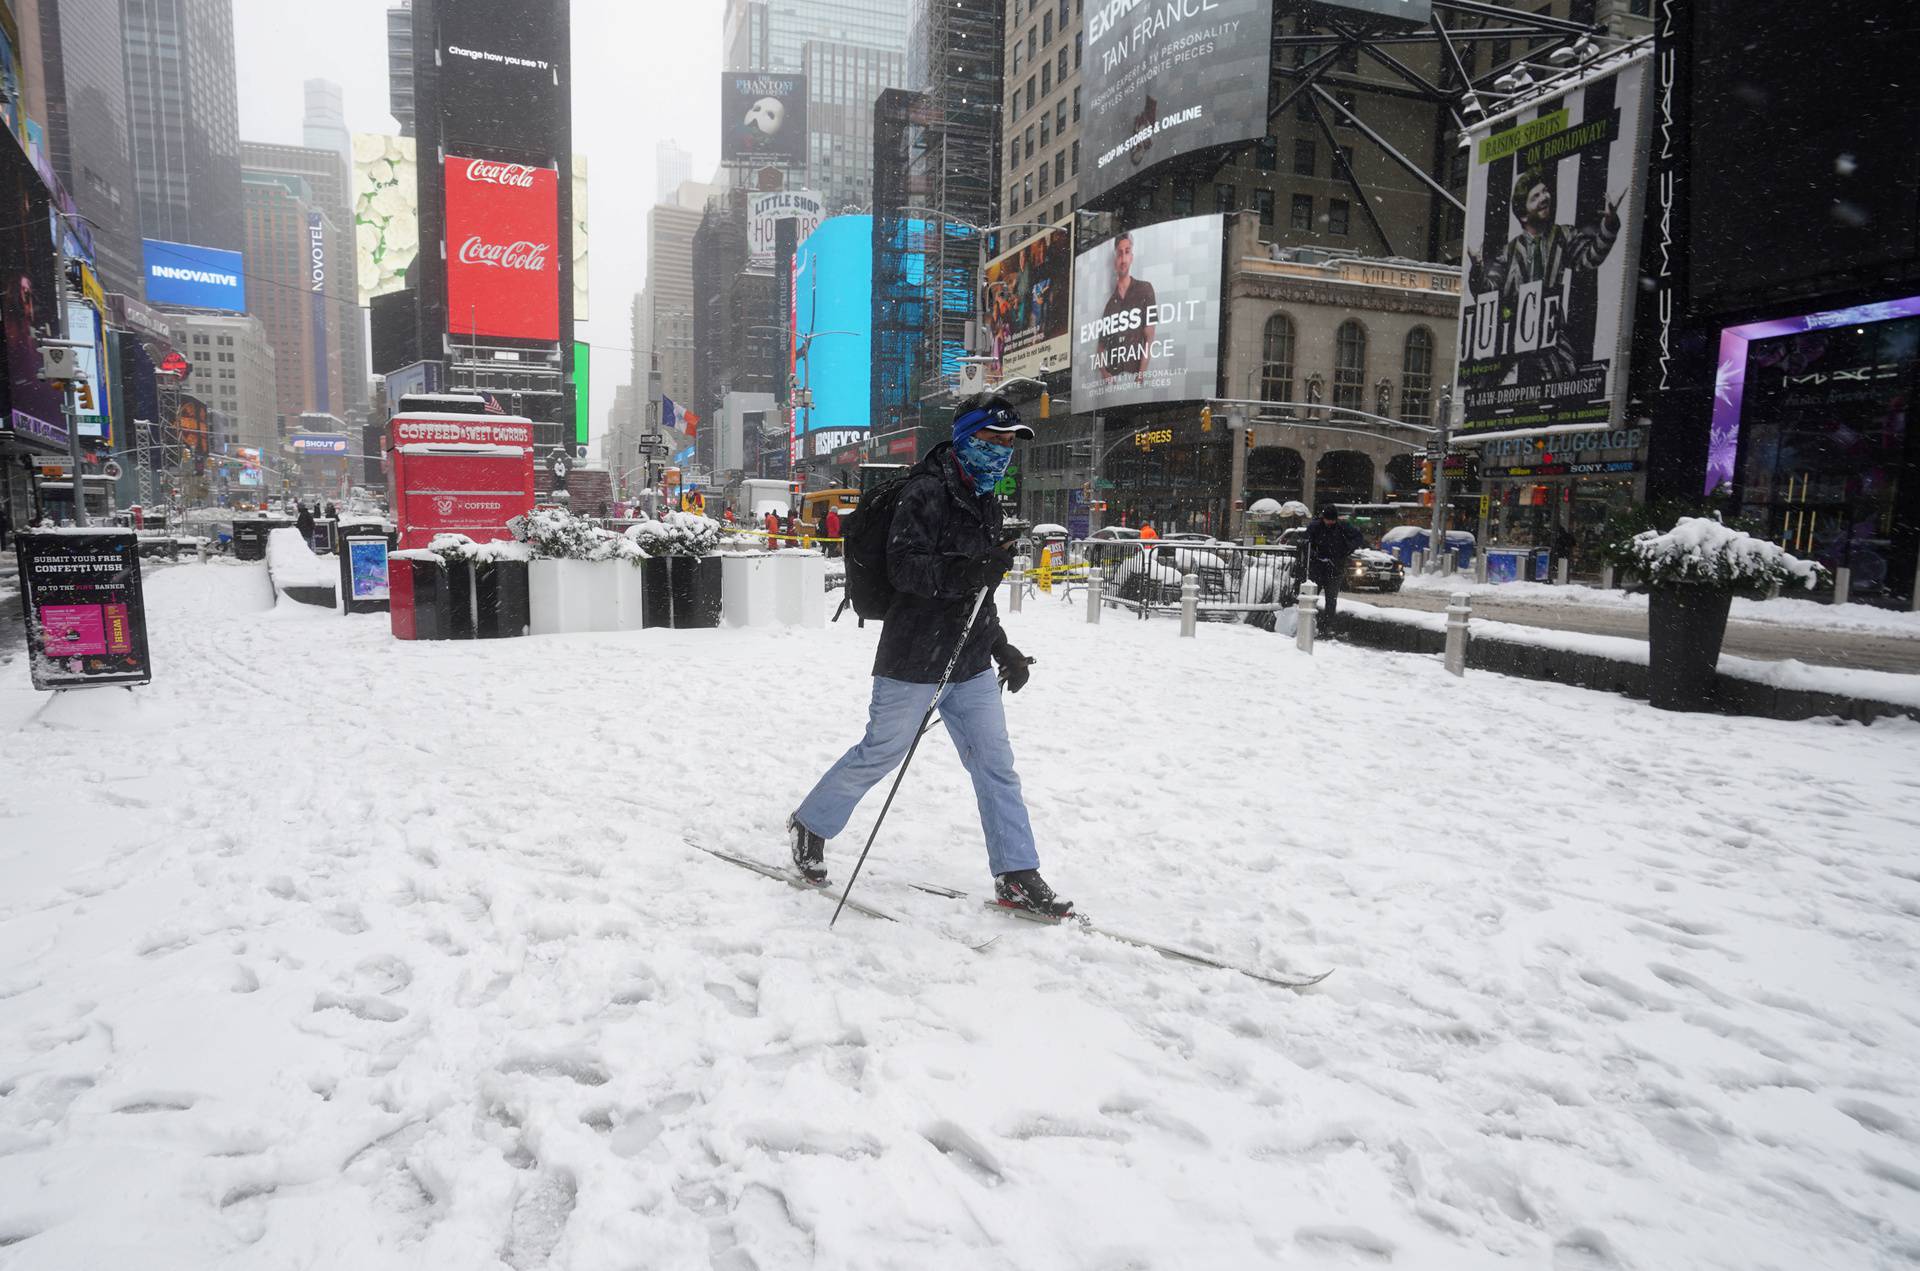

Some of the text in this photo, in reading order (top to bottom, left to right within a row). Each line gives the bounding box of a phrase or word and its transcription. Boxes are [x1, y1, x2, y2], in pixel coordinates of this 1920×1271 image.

[1088, 0, 1143, 46] EXPR
[448, 46, 548, 70] Change how you see TV
[1102, 35, 1128, 75] TAN
[1117, 65, 1141, 91] EXPERT
[1161, 20, 1240, 57] PERSONALITY
[735, 79, 793, 91] PHANTOM
[1100, 42, 1214, 115] STYLES HIS FAVORITE PIECES
[1098, 104, 1202, 168] SHOP IN-STORES & ONLINE
[1486, 115, 1560, 159] RAISING SPIRITS
[1527, 119, 1608, 165] ON BROADWAY!
[466, 159, 537, 188] Coca-Cola
[755, 194, 820, 215] LITTLE SHOP
[309, 222, 325, 292] NOVOTEL
[458, 236, 549, 271] Coca-Cola
[151, 265, 238, 287] INNOVATIVE
[1363, 268, 1418, 289] MILLER
[1080, 300, 1200, 344] EXPRESS EDIT
[1089, 338, 1175, 371] TAN FRANCE
[1134, 367, 1189, 380] PERSONALITY
[1144, 377, 1172, 387] PIECES
[1476, 384, 1541, 406] JAW-DROPPING
[399, 423, 460, 440] COFFEED
[465, 426, 491, 440] SWEET
[493, 427, 528, 442] CHURROS
[1485, 429, 1641, 456] GIFTS LUGGAGE
[1570, 463, 1602, 473] SONY
[464, 502, 501, 510] COFFEED
[1480, 495, 1488, 514] ATM
[35, 564, 123, 573] CONFETTI WISH
